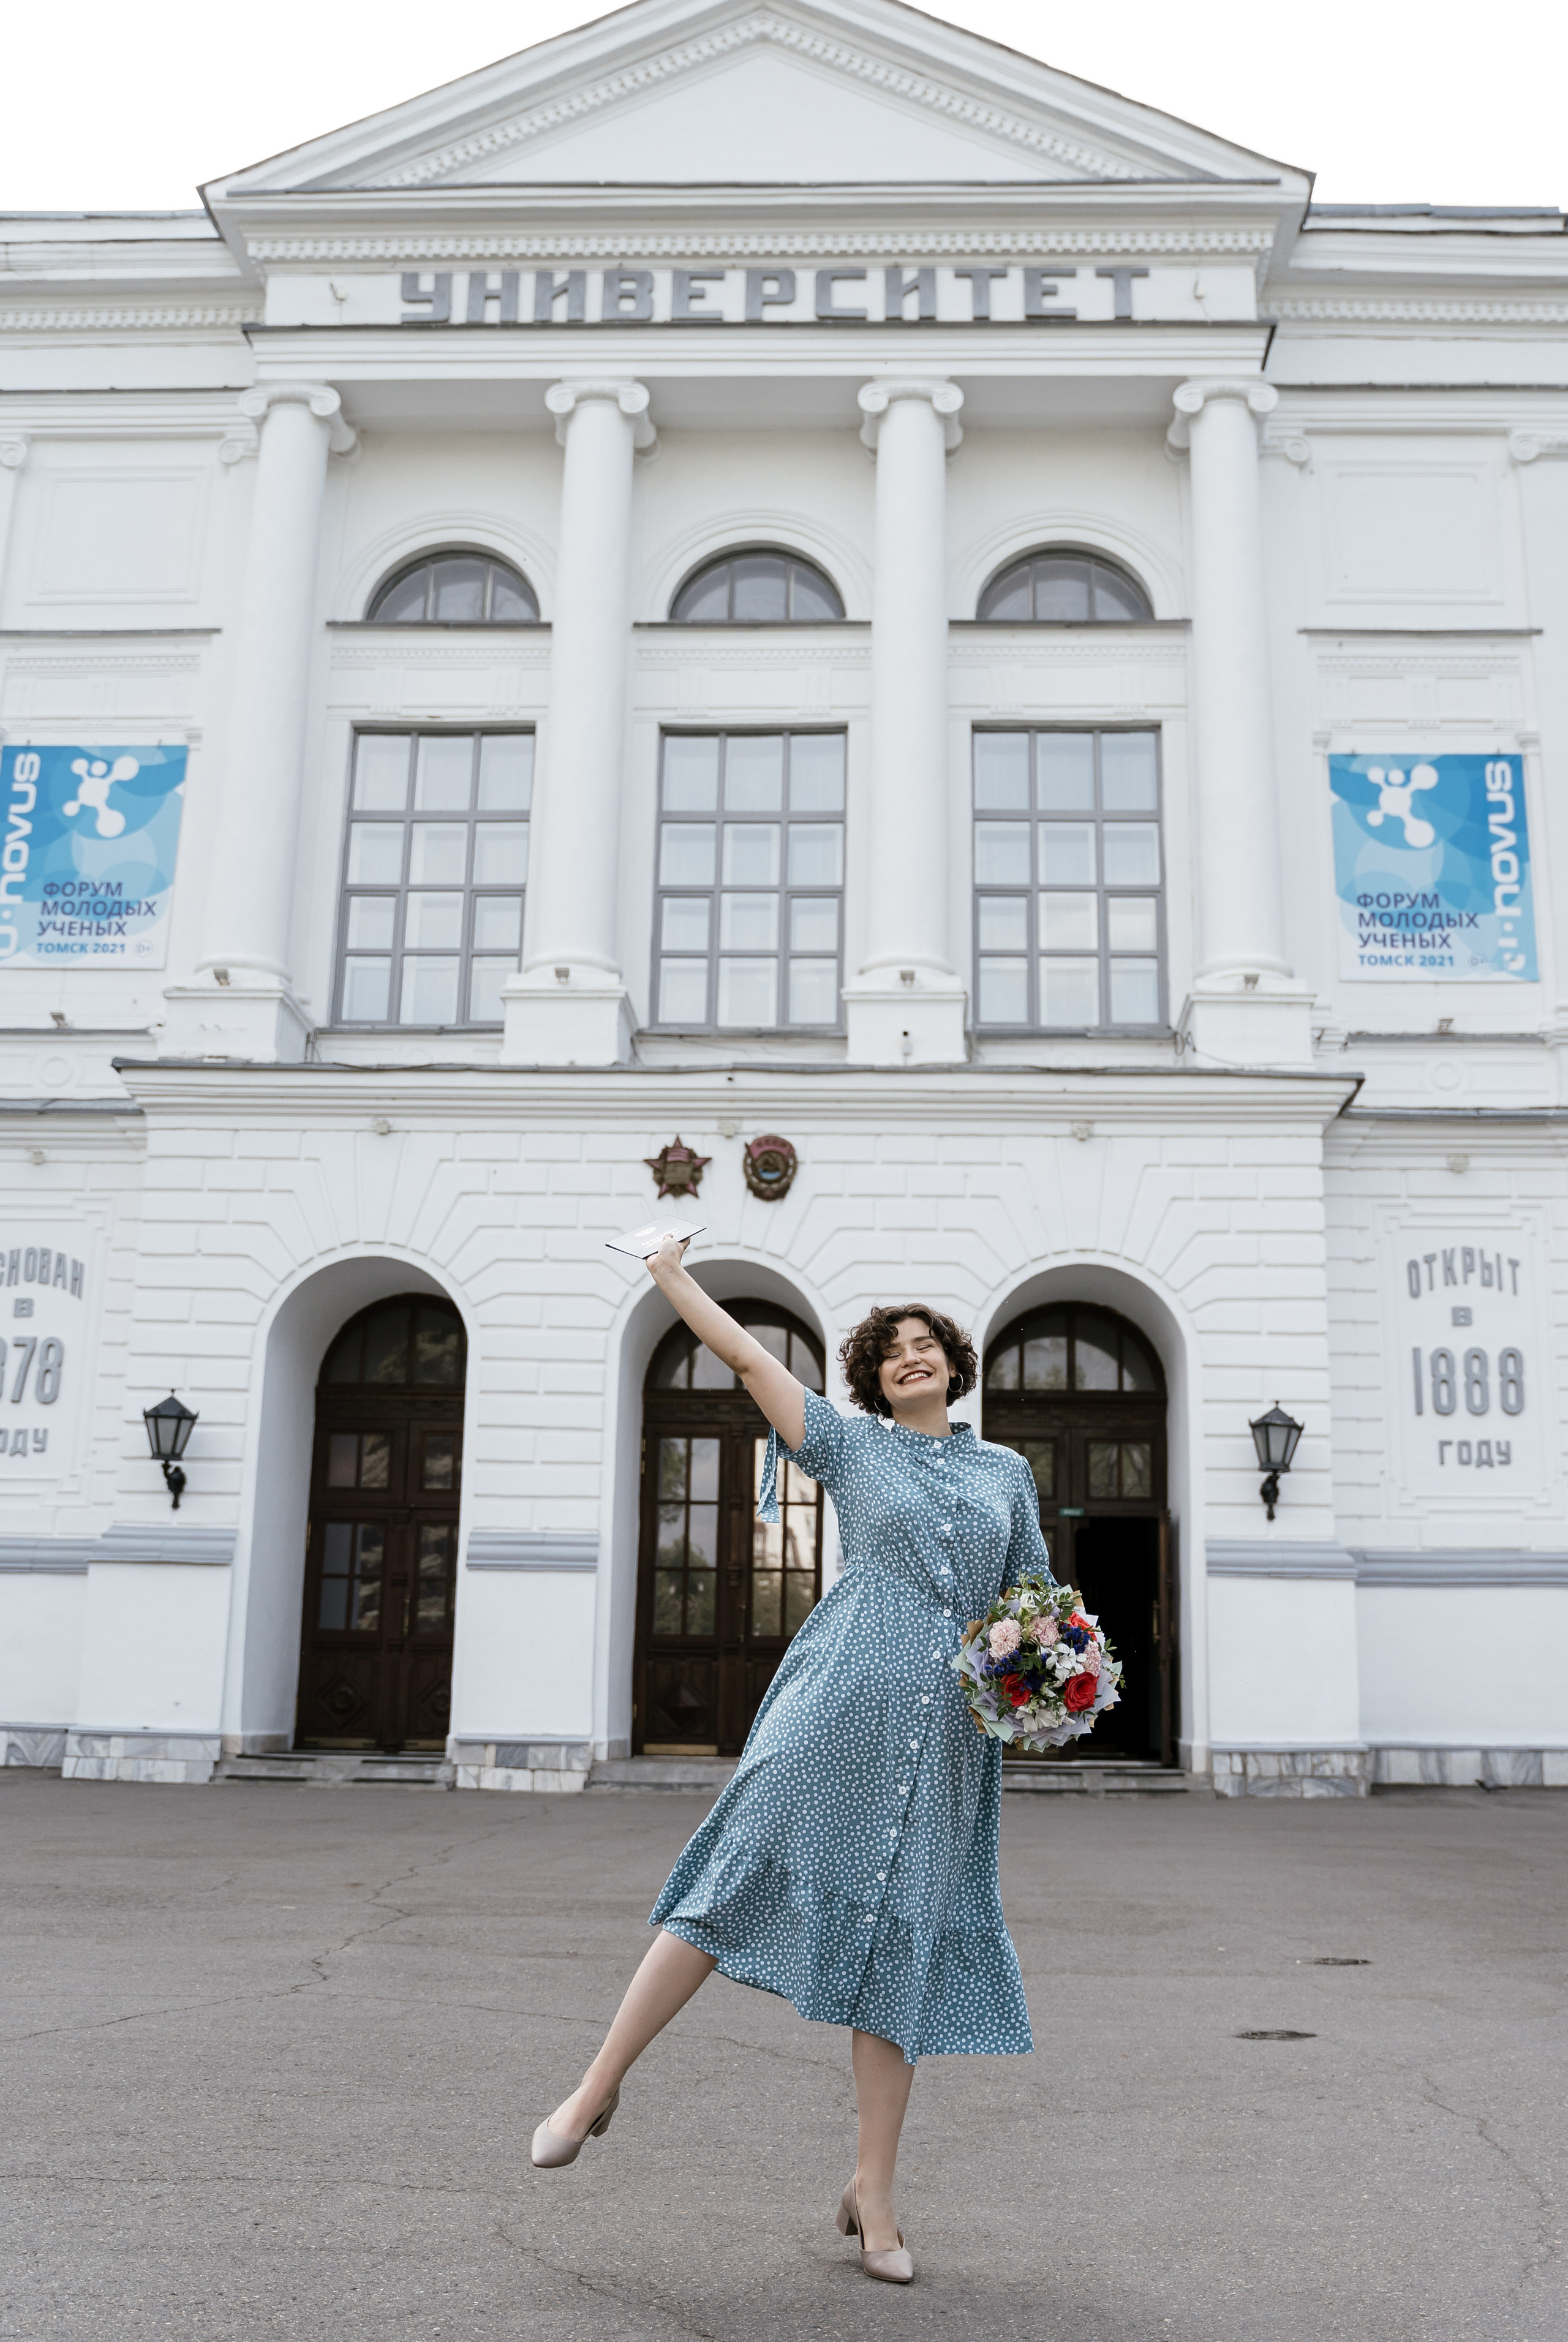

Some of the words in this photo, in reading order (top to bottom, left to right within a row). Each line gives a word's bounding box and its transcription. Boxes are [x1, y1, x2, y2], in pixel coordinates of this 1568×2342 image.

[400, 268, 1150, 325] УНИВЕРСИТЕТ
[43, 882, 123, 897] ФОРУМ
[40, 901, 157, 919] МОЛОДЫХ
[1357, 893, 1439, 909] ФОРУМ
[37, 921, 128, 936] УЧЕНЫХ
[1358, 913, 1479, 931] МОЛОДЫХ
[37, 943, 88, 954] ТОМСК
[93, 943, 126, 954] 2021
[1359, 933, 1452, 949] УЧЕНЫХ
[1359, 955, 1415, 966] ТОМСК
[1419, 955, 1455, 966] 2021
[1408, 1246, 1520, 1298] ОТКРЫТ
[13, 1298, 34, 1317] В
[1452, 1306, 1472, 1327] В
[1412, 1347, 1525, 1416] 1888
[1438, 1440, 1510, 1468] ГОДУ
